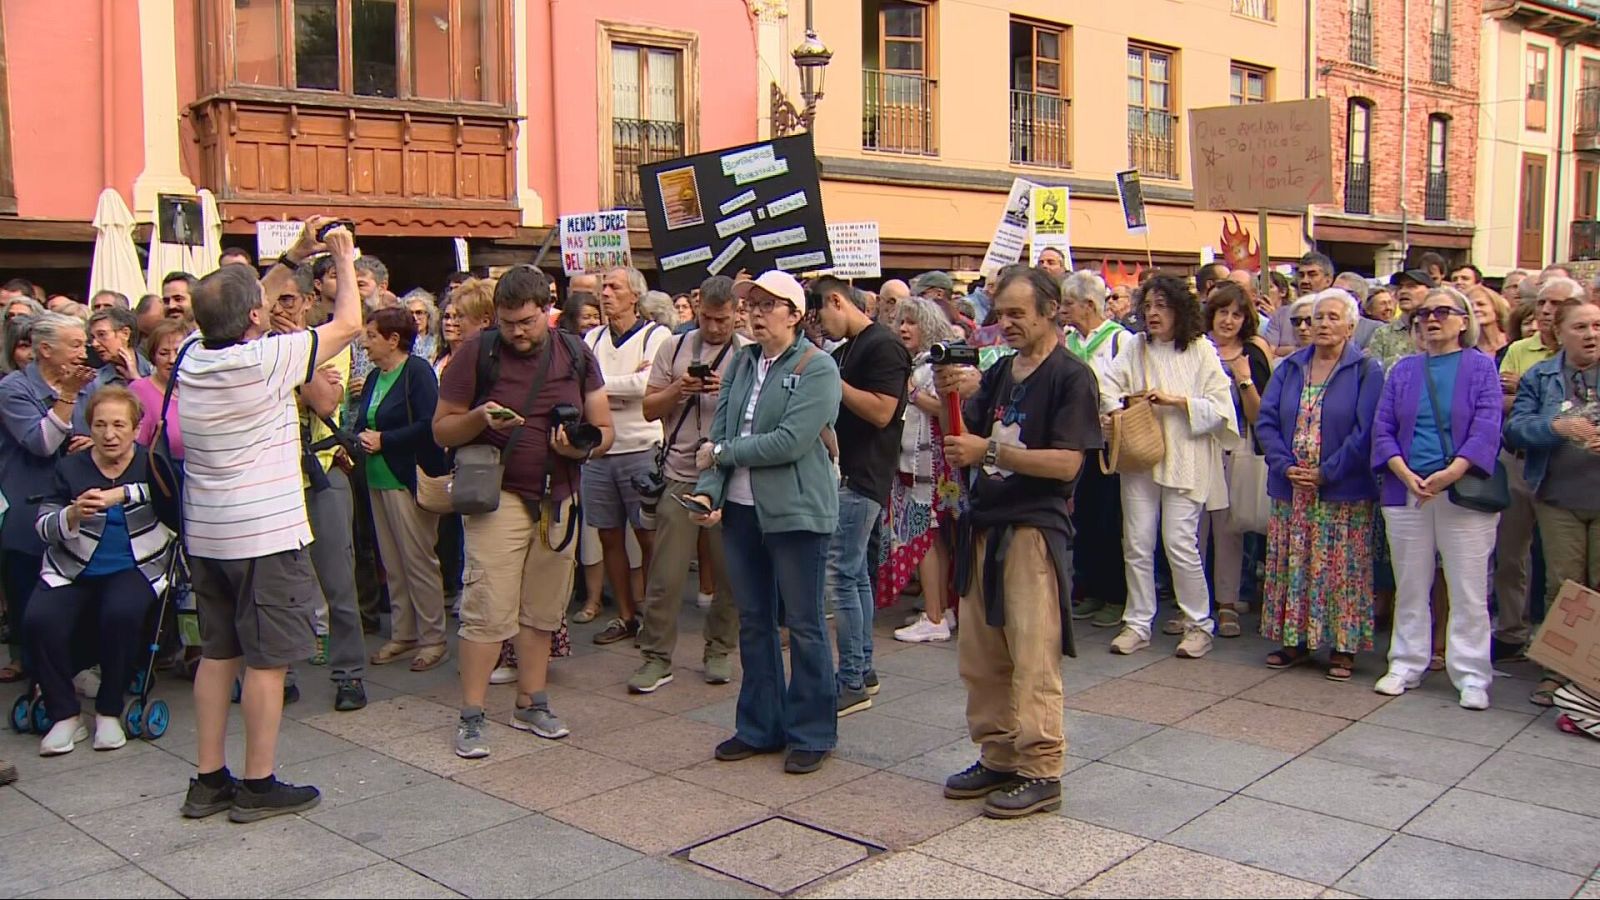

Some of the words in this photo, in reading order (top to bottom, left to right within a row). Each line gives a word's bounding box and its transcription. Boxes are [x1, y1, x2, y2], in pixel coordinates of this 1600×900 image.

[1251, 154, 1278, 169] NO
[567, 216, 596, 232] MENOS
[599, 214, 626, 232] TOROS
[588, 234, 621, 248] CUIDADO
[565, 253, 583, 270] DEL
